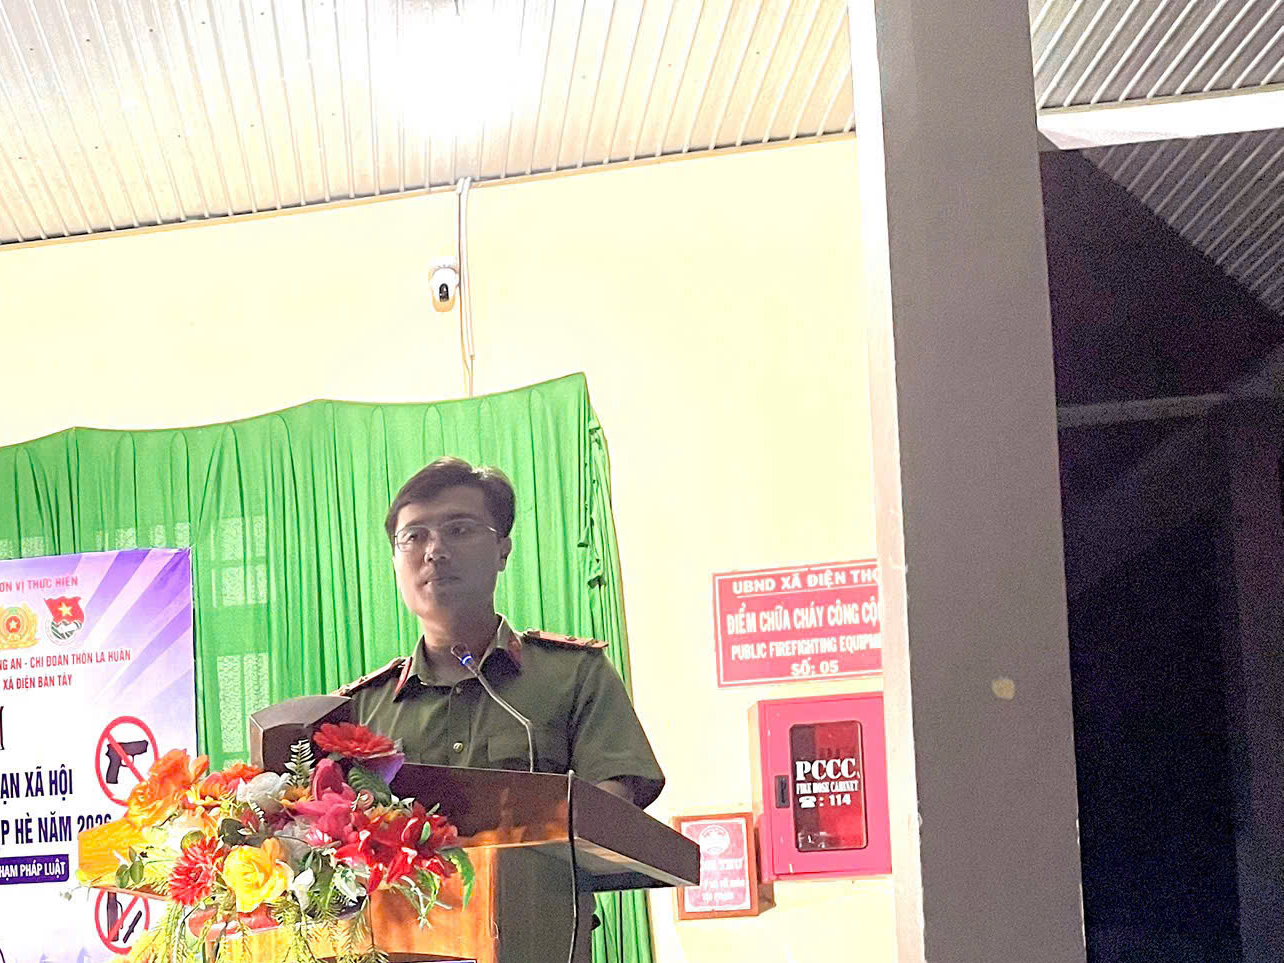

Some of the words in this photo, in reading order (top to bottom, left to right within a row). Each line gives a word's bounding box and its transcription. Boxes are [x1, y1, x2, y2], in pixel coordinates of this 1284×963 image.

[732, 577, 776, 594] UBND
[807, 569, 846, 588] ĐIỆN
[726, 602, 756, 635] ĐIỂM
[759, 605, 791, 633] CHỮA
[793, 601, 824, 629] CHÁY
[828, 598, 860, 626] CÔNG
[10, 658, 22, 670] AN
[30, 655, 44, 668] CHI
[46, 652, 69, 667] ĐOÀN
[731, 642, 767, 661] PUBLIC
[820, 660, 839, 673] 05
[25, 766, 44, 797] XÃ
[49, 764, 73, 801] HỘI
[829, 793, 851, 806] 114
[15, 812, 33, 845] HÈ
[38, 811, 72, 842] NĂM
[20, 860, 42, 877] PHÁP
[44, 858, 66, 879] LUẬT
